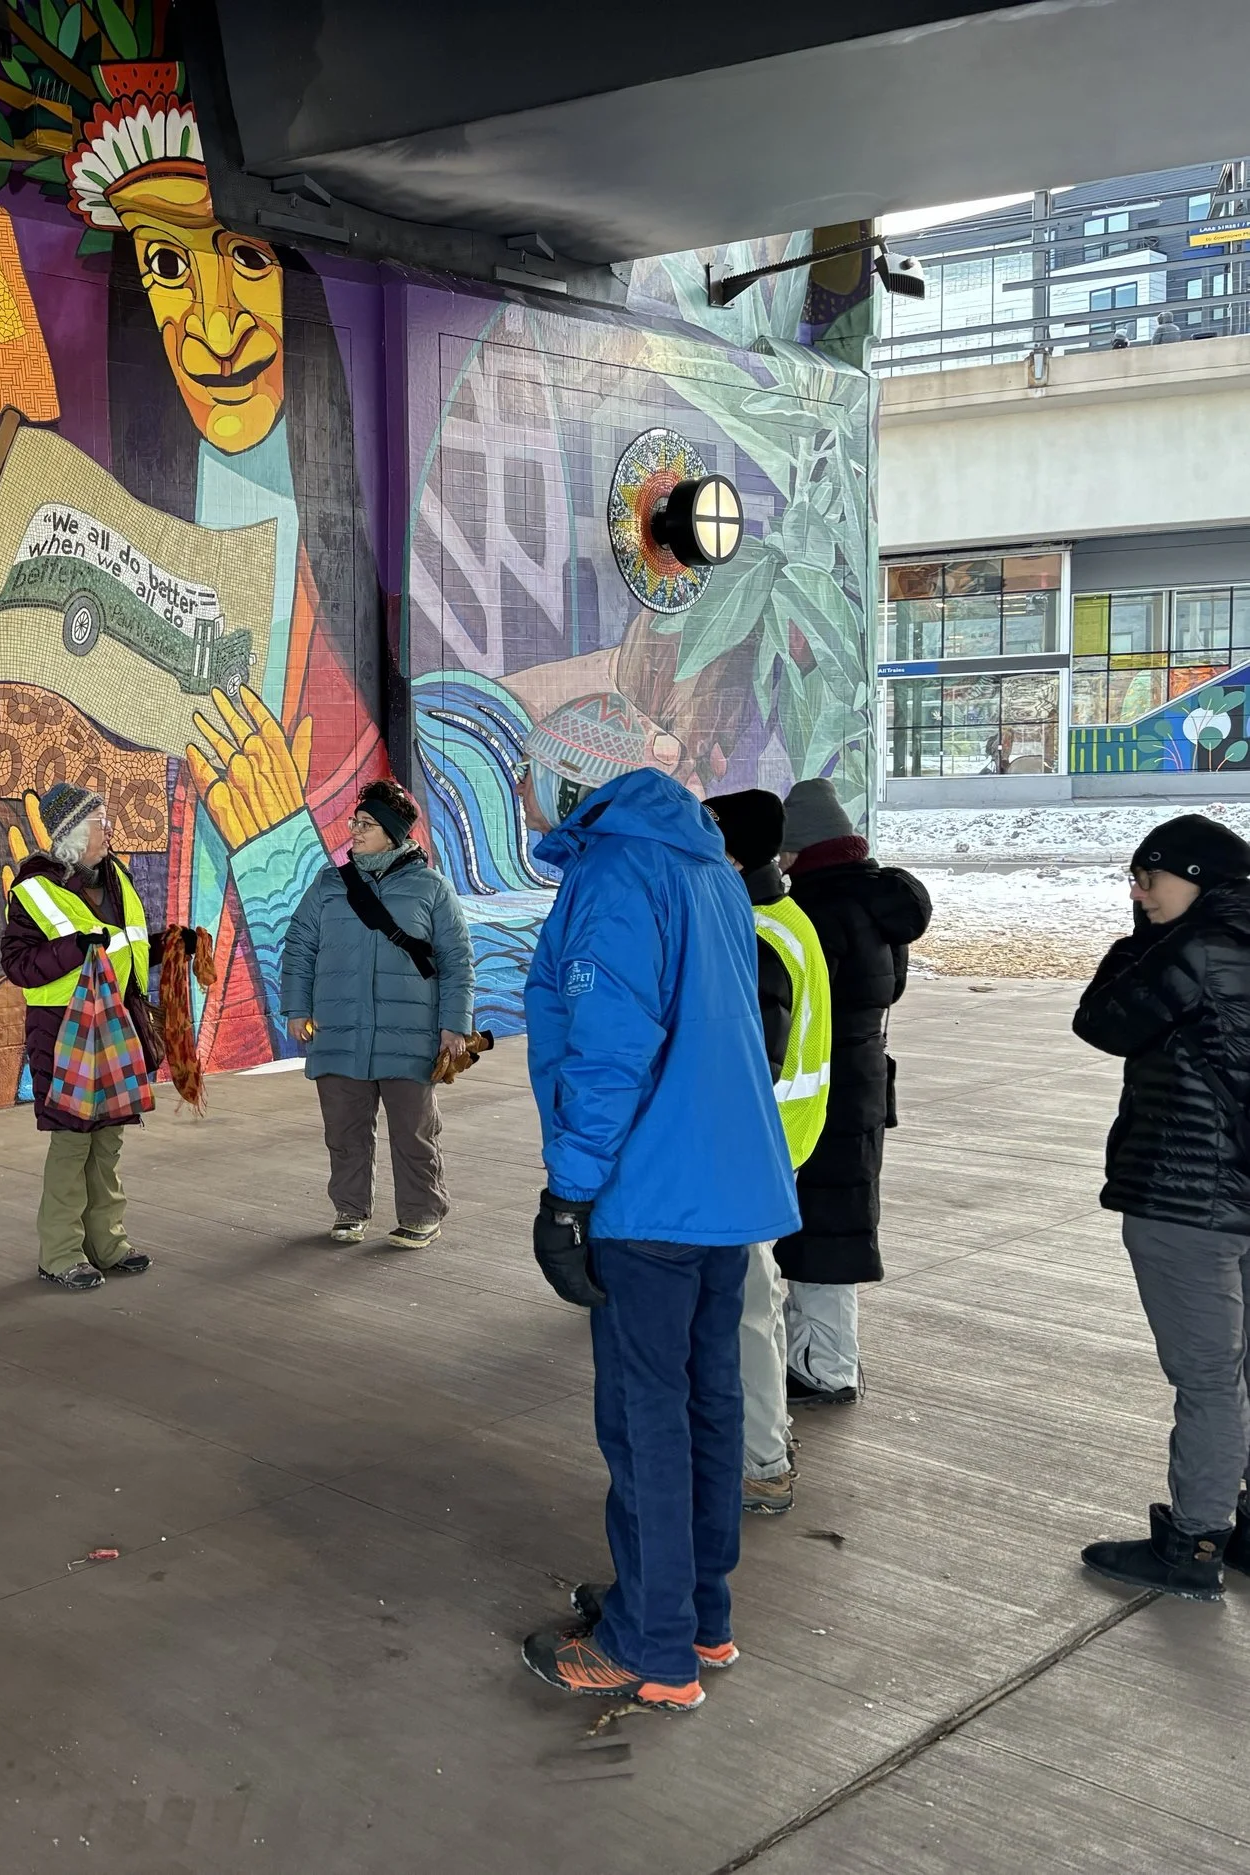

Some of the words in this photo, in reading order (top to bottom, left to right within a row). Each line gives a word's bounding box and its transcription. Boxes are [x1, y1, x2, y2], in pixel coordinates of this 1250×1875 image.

[28, 533, 85, 557] when
[97, 552, 122, 577] we
[135, 581, 157, 607] all
[163, 606, 184, 629] do
[87, 525, 110, 552] all
[119, 545, 141, 575] do
[148, 563, 198, 615] better
